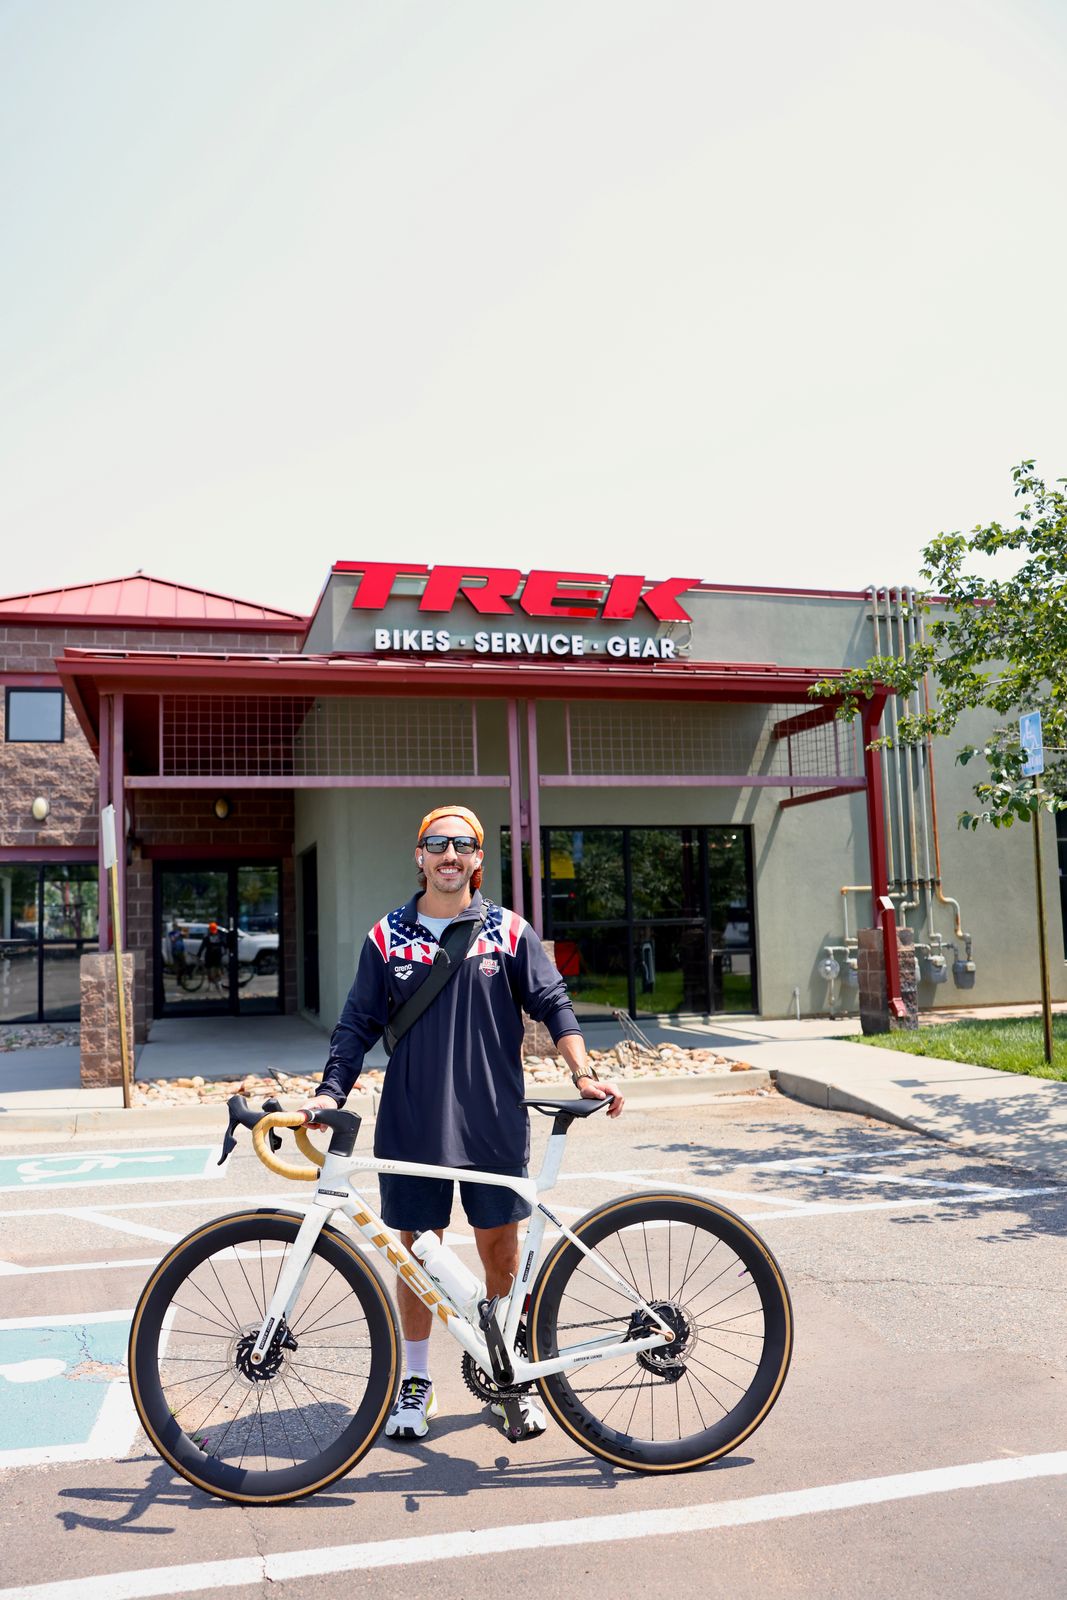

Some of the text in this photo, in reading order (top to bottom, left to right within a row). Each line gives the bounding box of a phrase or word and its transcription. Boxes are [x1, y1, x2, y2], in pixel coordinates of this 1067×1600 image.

[333, 560, 704, 623] TREK
[374, 628, 677, 659] BIKES SERVICE GEAR
[395, 963, 412, 972] arena
[352, 1200, 460, 1327] TREK
